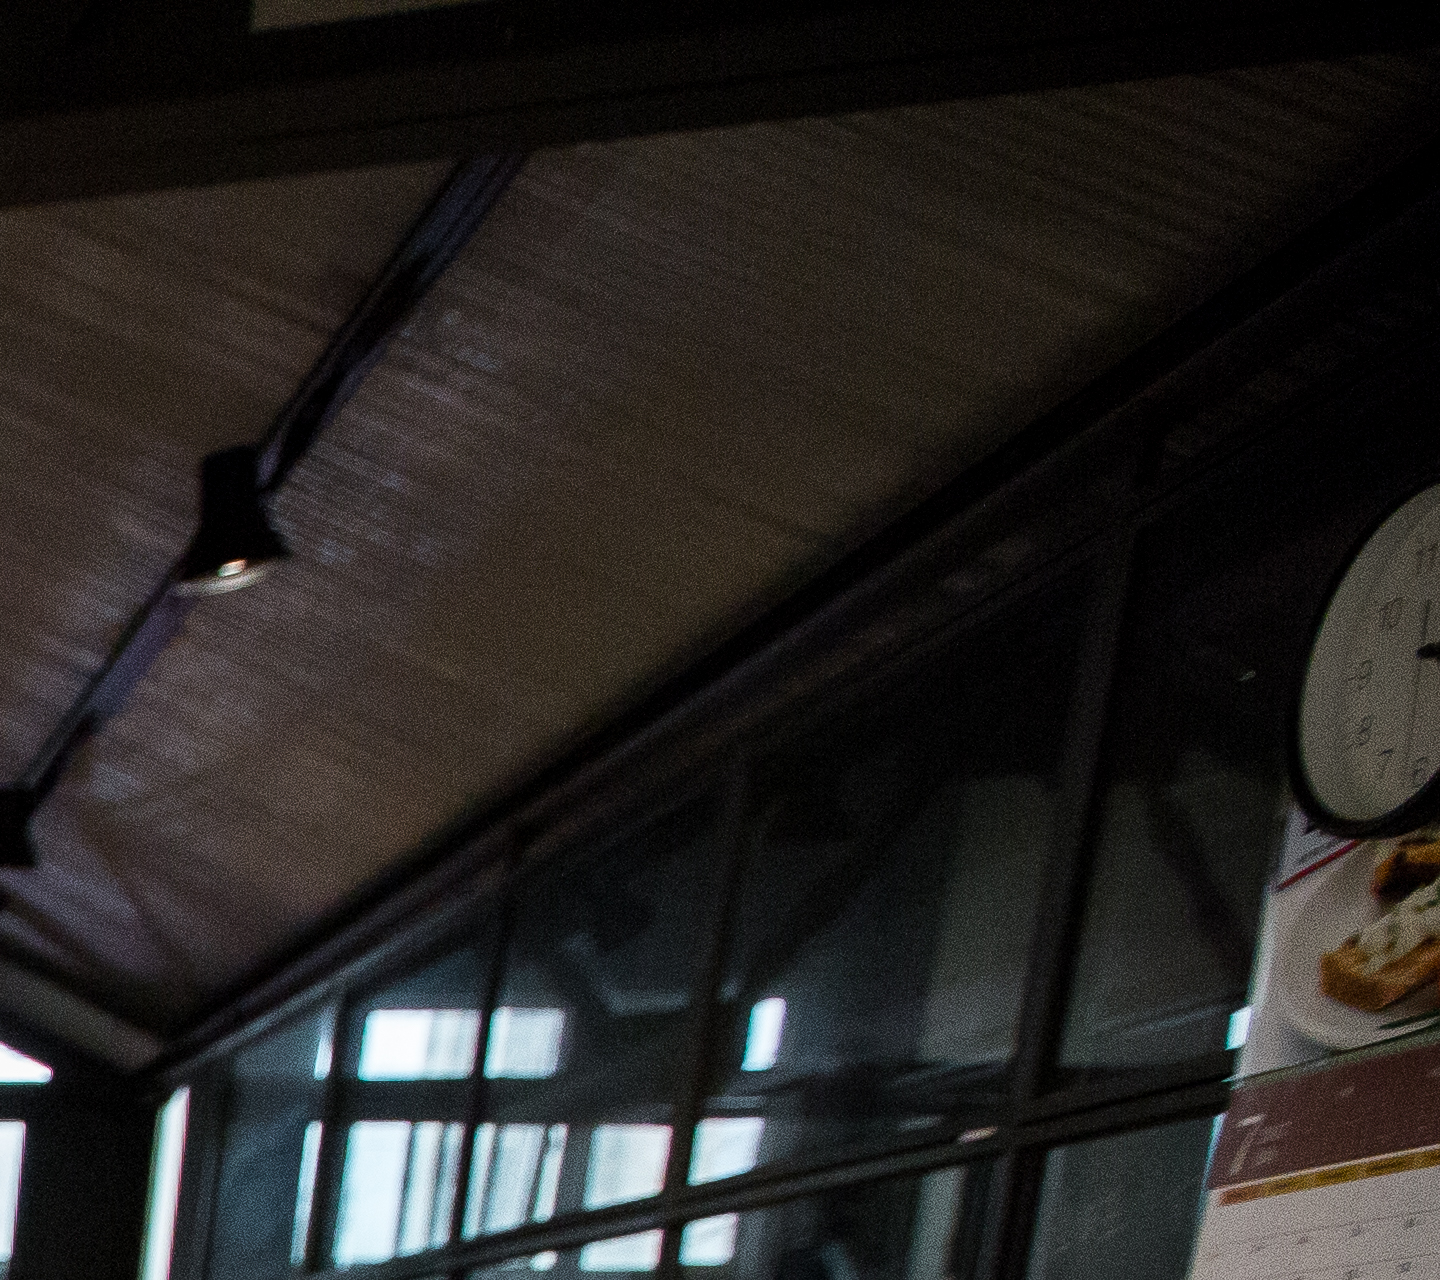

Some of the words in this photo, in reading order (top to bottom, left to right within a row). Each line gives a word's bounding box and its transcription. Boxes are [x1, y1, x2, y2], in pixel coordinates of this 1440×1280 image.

[1378, 597, 1402, 631] 10
[1356, 714, 1376, 747] 8
[1377, 748, 1394, 780] 7
